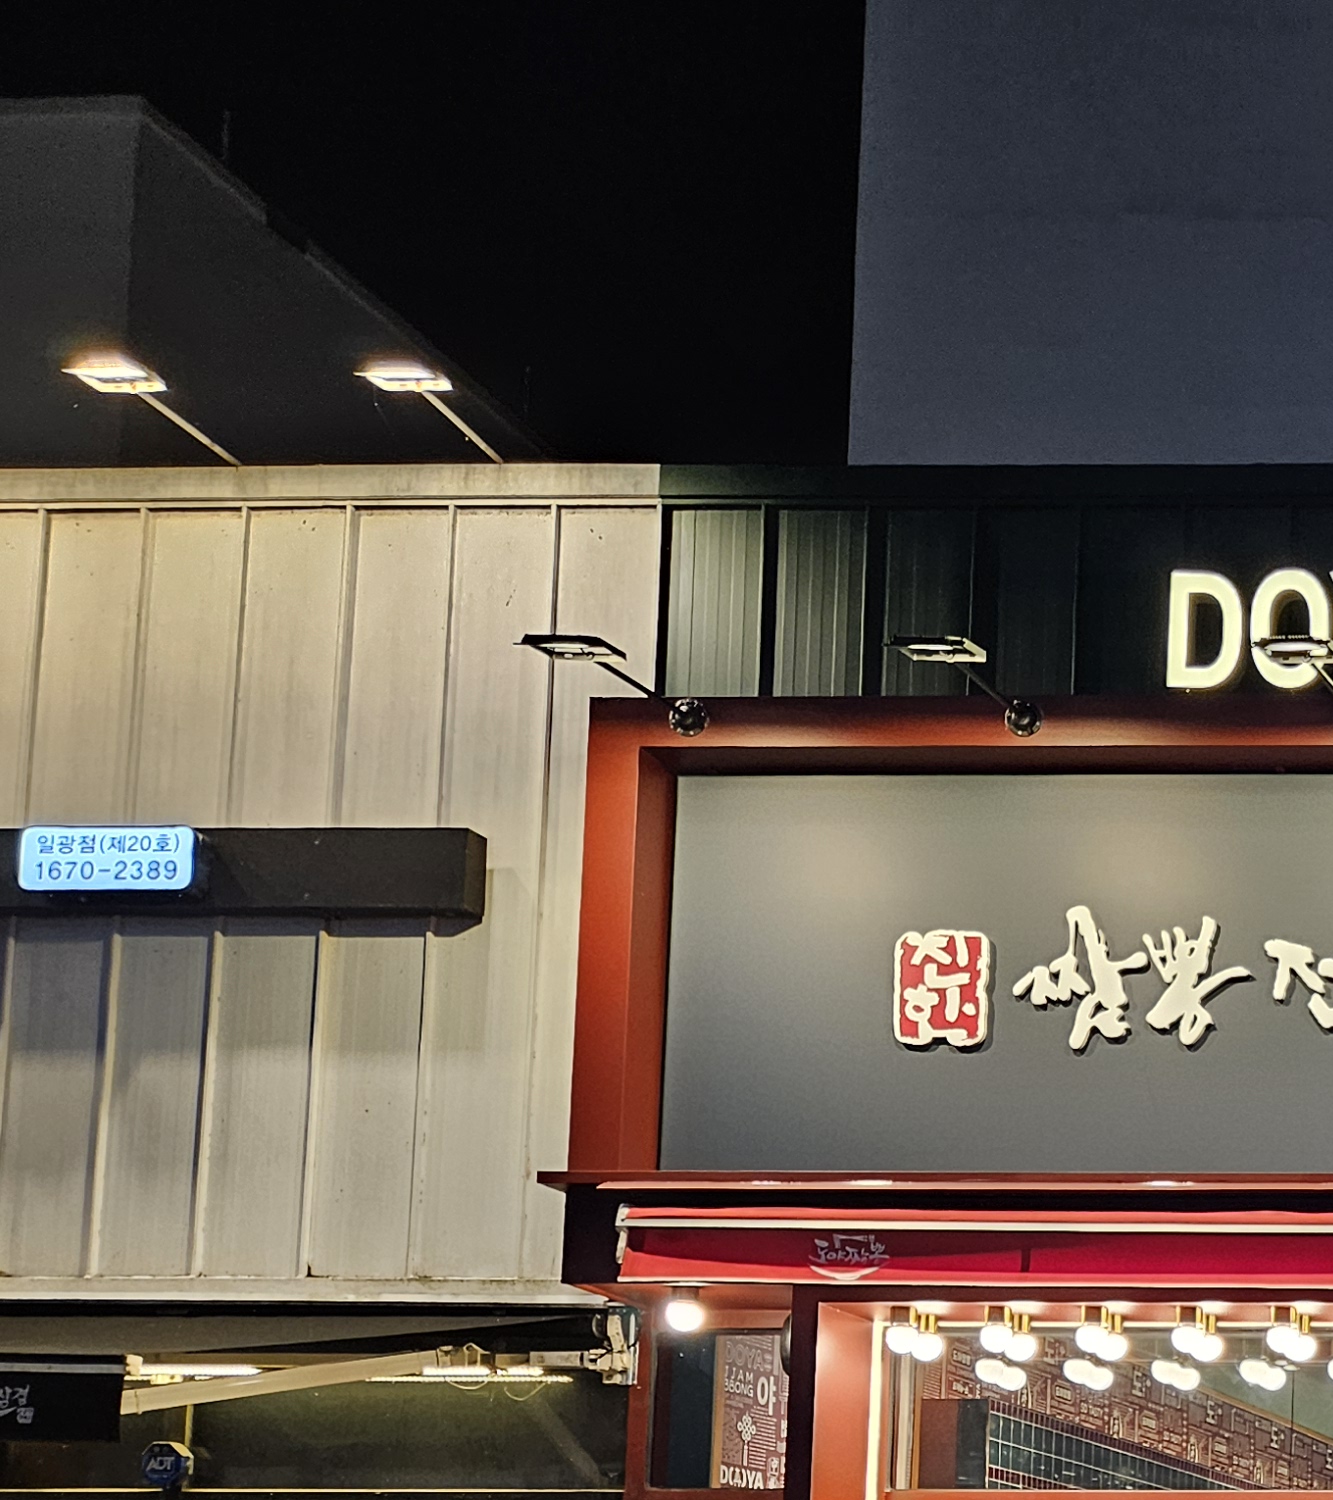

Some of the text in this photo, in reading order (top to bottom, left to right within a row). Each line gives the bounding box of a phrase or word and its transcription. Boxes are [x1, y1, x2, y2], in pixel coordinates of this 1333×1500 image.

[37, 833, 181, 855] 일광점(제20호)
[35, 859, 178, 881] 1670-2389
[1012, 904, 1252, 1050] 짬뽕
[146, 1456, 175, 1472] ADT
